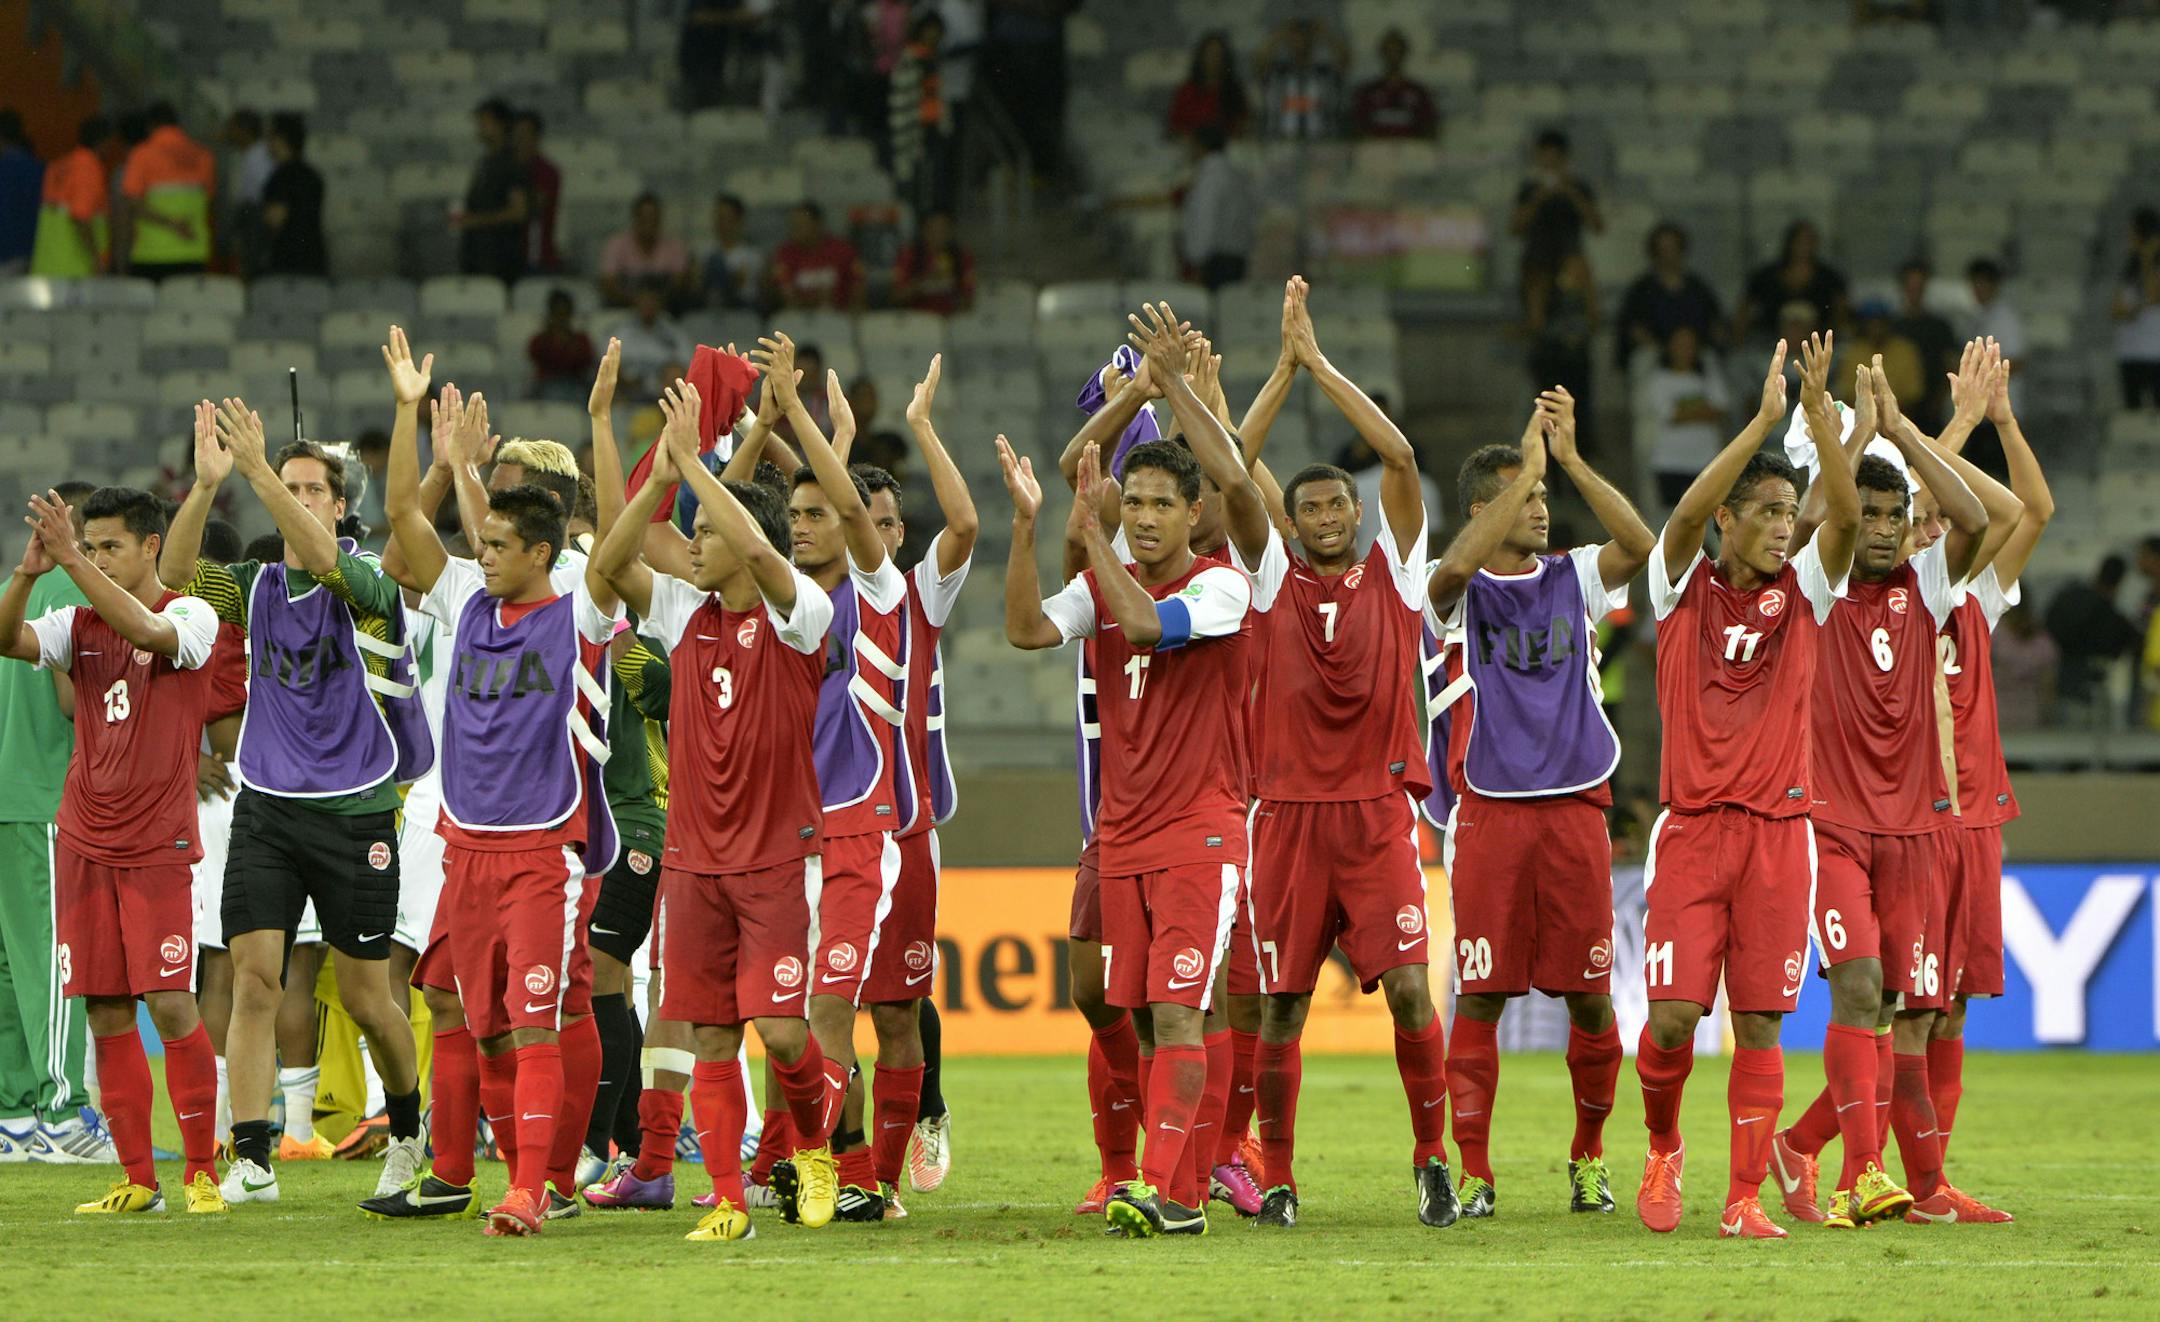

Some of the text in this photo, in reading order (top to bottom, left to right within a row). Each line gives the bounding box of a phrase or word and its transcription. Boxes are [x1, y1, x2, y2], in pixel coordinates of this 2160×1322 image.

[1319, 602, 1338, 643] 7
[1723, 624, 1764, 662] 11
[1871, 628, 1894, 672] 6
[104, 679, 131, 722] 13
[713, 667, 732, 709] 3
[1825, 908, 1847, 950] 6
[1261, 940, 1279, 983] 7
[1459, 937, 1493, 981] 20
[1645, 941, 1673, 986] 11
